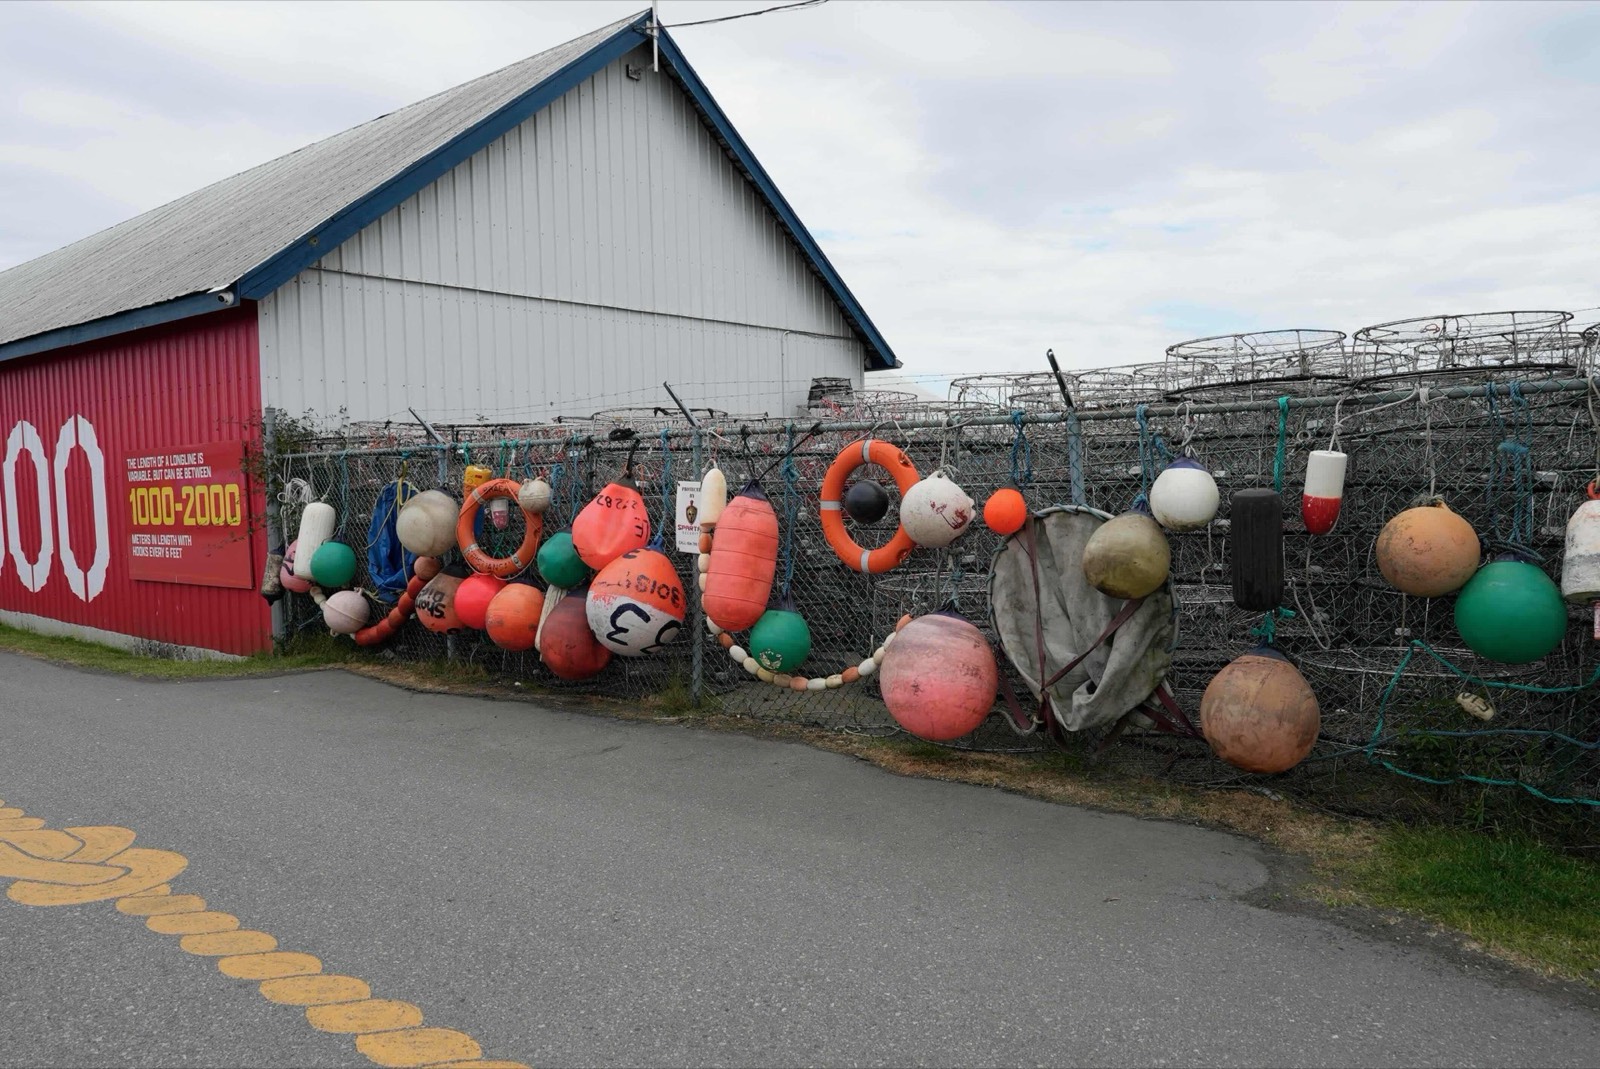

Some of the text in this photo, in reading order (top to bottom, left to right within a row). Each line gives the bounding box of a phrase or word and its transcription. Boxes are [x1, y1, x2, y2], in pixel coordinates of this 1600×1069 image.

[127, 452, 204, 469] THE LENGTH OF A LONGLINE IS
[127, 466, 212, 482] VARIABLE, BUT CAN BE BETWEEN
[0, 413, 110, 603] 00
[130, 484, 241, 526] 1000-2000
[131, 534, 192, 546] METERS IN LENGTH WITH
[132, 546, 149, 557] HOOKS
[149, 547, 164, 557] EVERY
[170, 547, 182, 559] FEET
